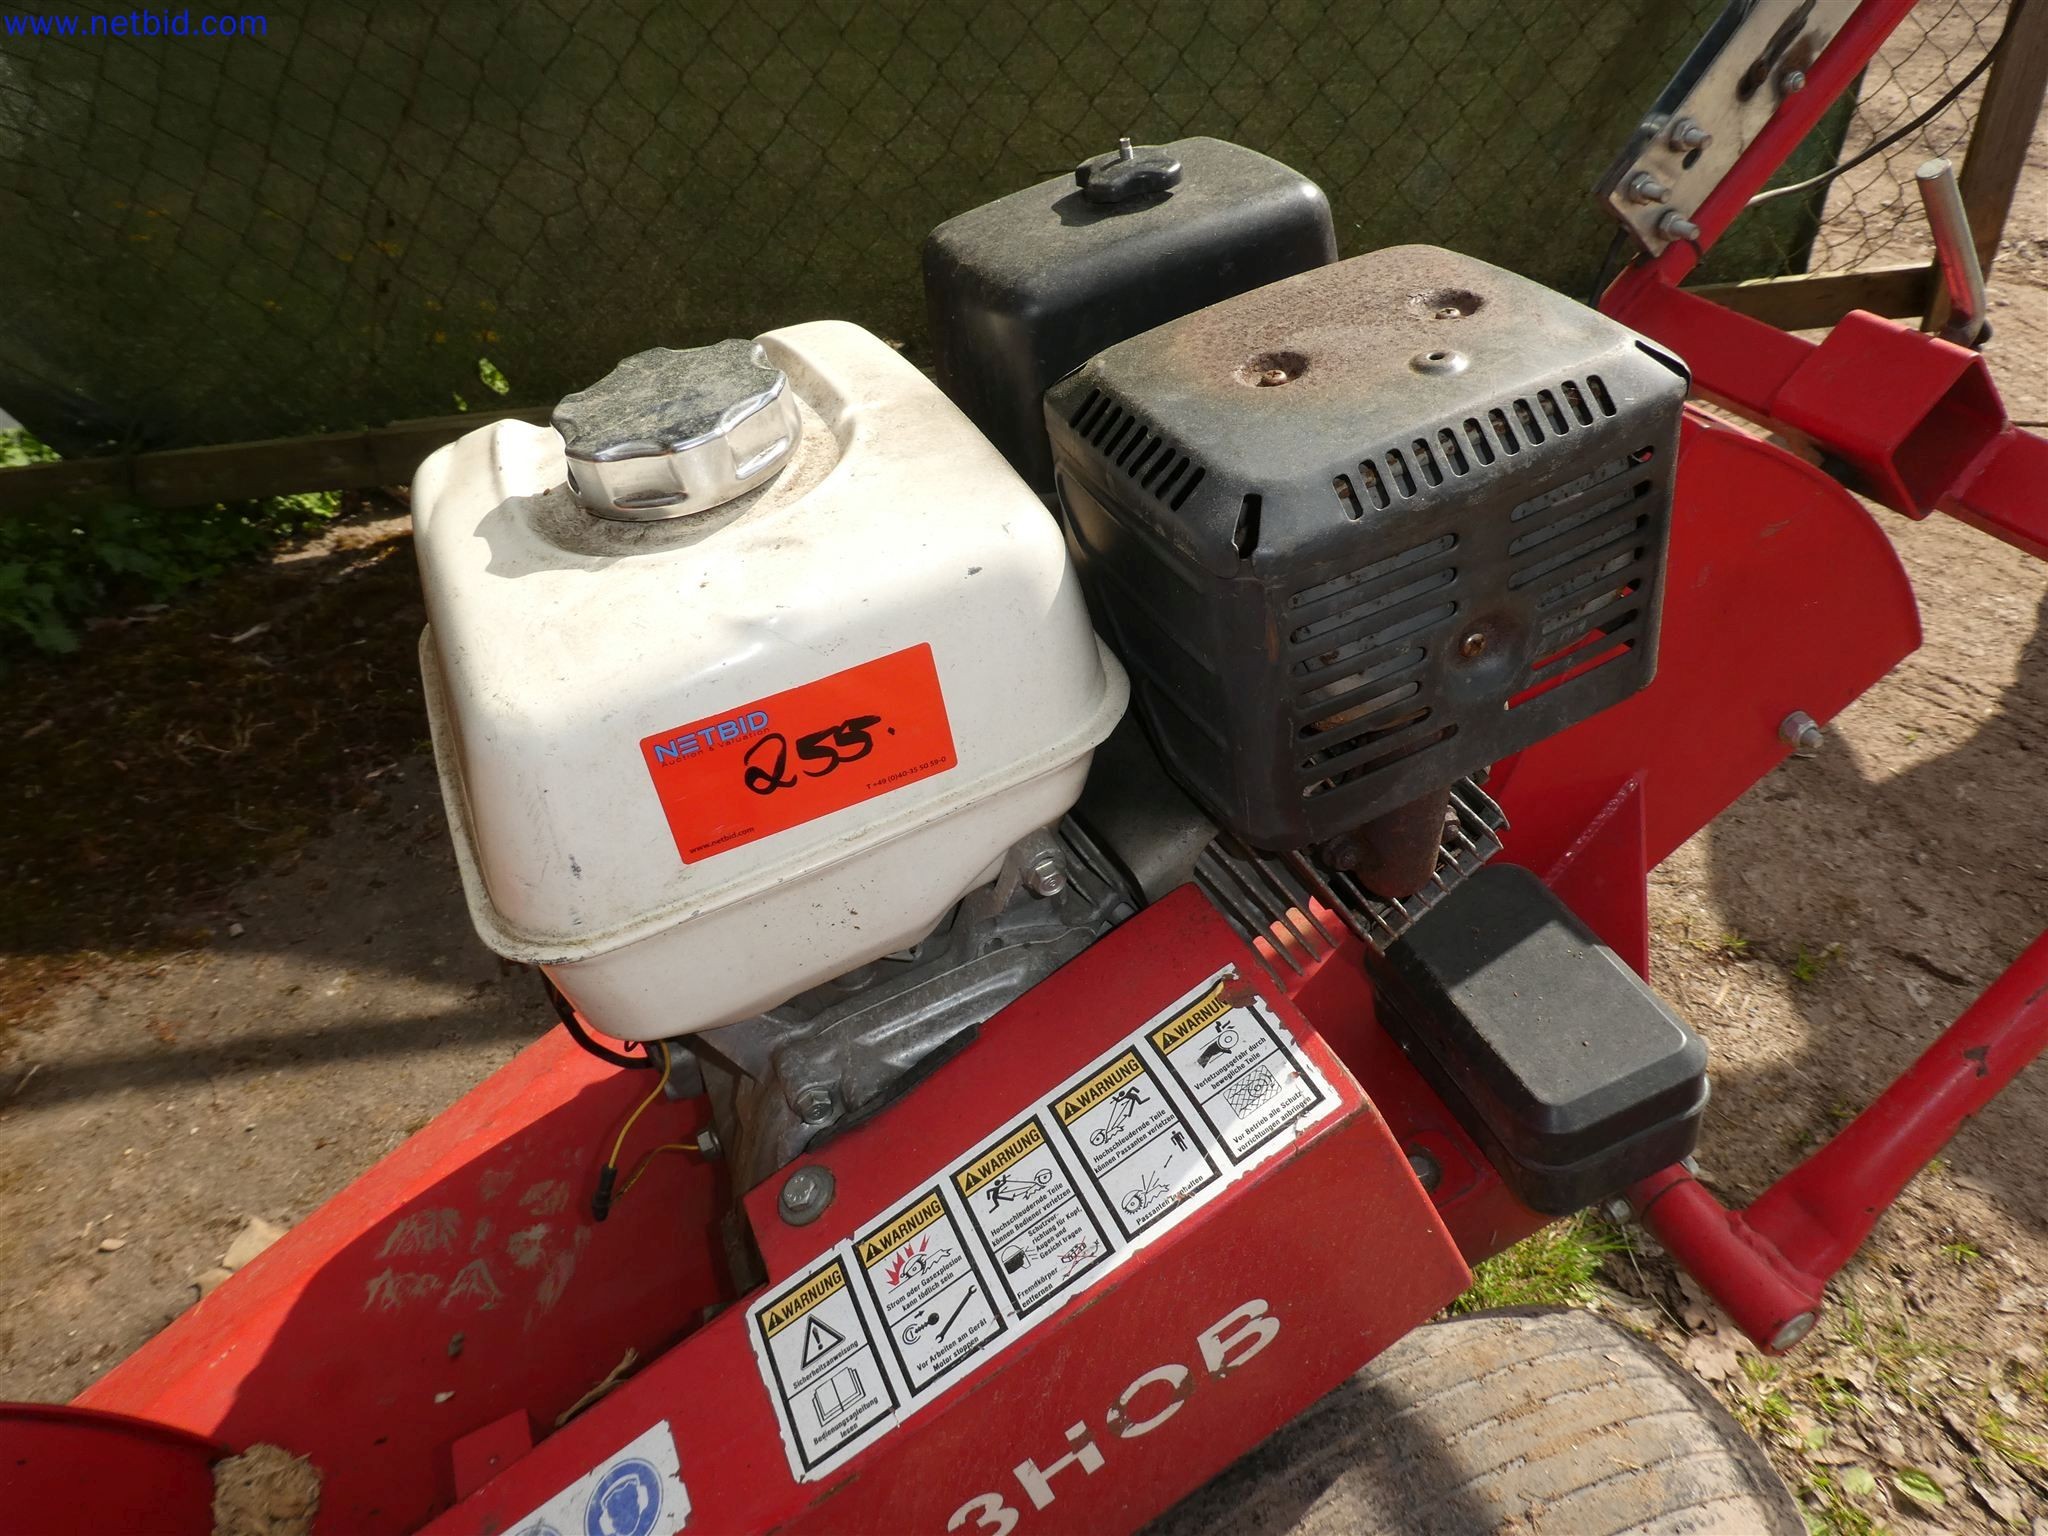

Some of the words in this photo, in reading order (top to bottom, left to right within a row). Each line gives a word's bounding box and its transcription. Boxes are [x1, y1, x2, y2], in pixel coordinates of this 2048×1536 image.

[654, 711, 769, 763] NETBID
[661, 750, 704, 768] Auction
[717, 727, 771, 748] Valuation
[873, 778, 887, 786] +49
[888, 767, 918, 783] (0)40-35
[919, 763, 929, 771] 50
[930, 756, 946, 767] 59-0
[689, 827, 754, 854] www.netbid.com
[1174, 996, 1229, 1037] WARNUN
[1076, 1059, 1140, 1108] WARNUNG
[1194, 1051, 1248, 1090] Verletzungsgefahr
[1248, 1037, 1267, 1052] durch
[1211, 1063, 1246, 1090] bewegliche
[1245, 1052, 1261, 1065] Teile
[1092, 1120, 1150, 1163] Hochschleudernde
[1150, 1108, 1167, 1122] Teile
[1093, 1156, 1117, 1174] können
[1116, 1133, 1148, 1158] Passanten
[1147, 1114, 1175, 1136] verletzen
[1233, 1132, 1246, 1143] Vor
[1245, 1116, 1269, 1135] Betrieb
[1269, 1106, 1280, 1118] alle
[1237, 1121, 1280, 1153] vorrichtungen
[1280, 1096, 1312, 1121] anbringen
[977, 1128, 1041, 1178] WARNUNG
[879, 1200, 941, 1249] WARNUNG
[990, 1195, 1048, 1237] Hochschleudernde
[1047, 1182, 1064, 1195] Teile
[991, 1230, 1015, 1248] können
[1014, 1210, 1042, 1231] Bediener
[1042, 1188, 1071, 1211] verletzen
[1027, 1213, 1059, 1237] Schutzvor-
[1136, 1199, 1171, 1226] Passanten
[1032, 1222, 1057, 1245] richtung
[1056, 1216, 1067, 1227] für
[1036, 1235, 1055, 1252] Augen
[1055, 1227, 1067, 1238] und
[1039, 1240, 1063, 1259] Gesicht
[1062, 1226, 1083, 1244] tragen
[781, 1270, 842, 1319] WARNUNG
[886, 1295, 906, 1311] Strom
[906, 1285, 920, 1297] oder
[921, 1255, 962, 1286] Gasexplosion
[902, 1298, 918, 1311] kann
[918, 1281, 940, 1300] tödlich
[940, 1272, 954, 1284] sein
[1017, 1267, 1058, 1299] Fremdkörper
[1021, 1283, 1053, 1308] entfernen
[792, 1341, 858, 1389] Sicherheitsanweisung
[916, 1360, 929, 1371] Vor
[929, 1341, 957, 1362] Arbeiten
[957, 1332, 968, 1342] am
[968, 1318, 987, 1334] Gerät
[932, 1355, 952, 1372] Motor
[953, 1336, 979, 1357] stoppen
[840, 1423, 858, 1438] lesen
